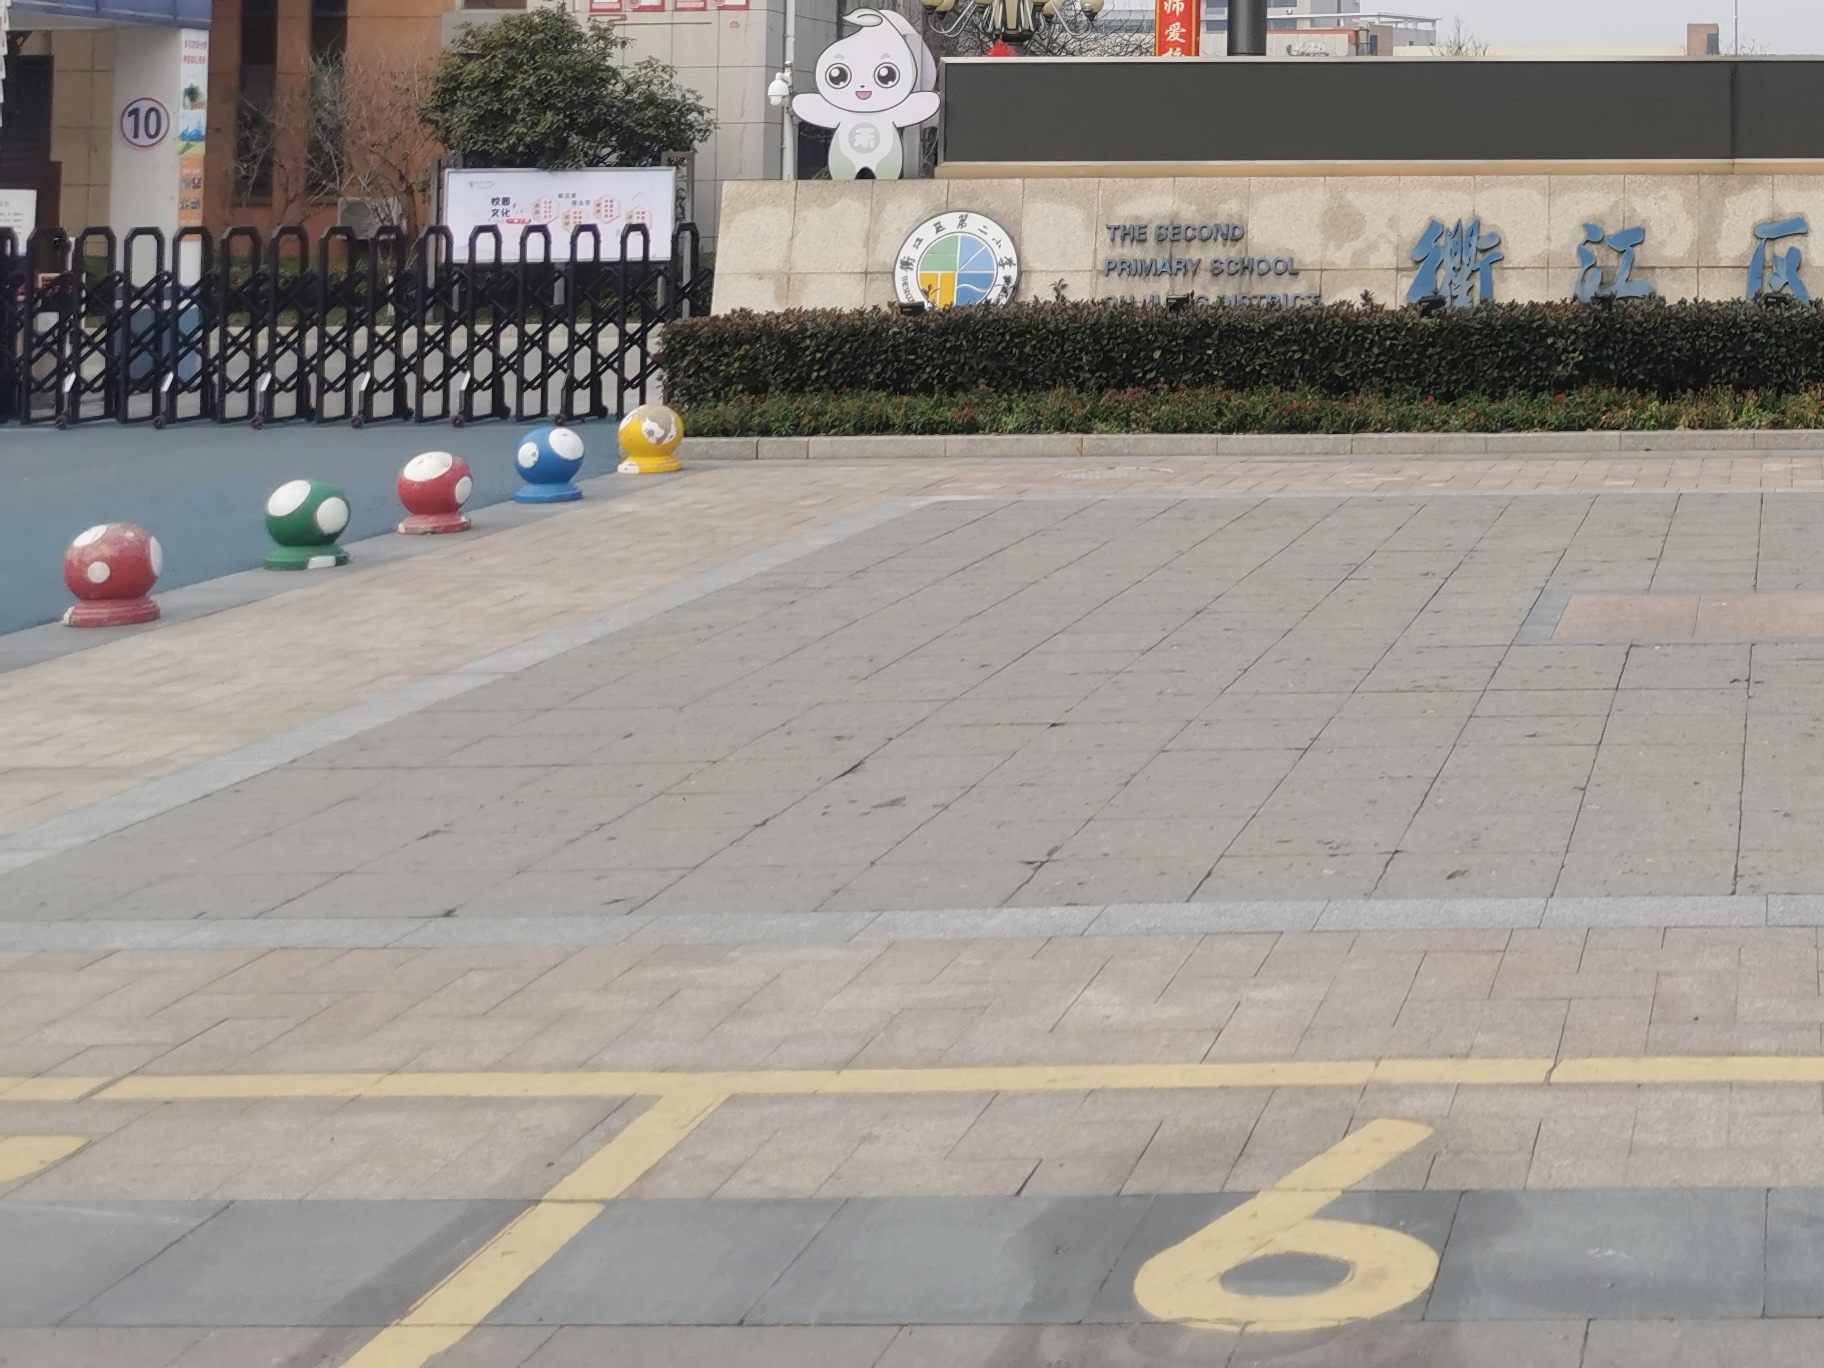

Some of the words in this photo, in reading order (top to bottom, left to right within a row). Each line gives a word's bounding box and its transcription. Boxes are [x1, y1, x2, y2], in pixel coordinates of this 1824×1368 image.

[127, 107, 162, 139] 10
[491, 208, 511, 218] 文化
[1106, 223, 1148, 242] THE
[1154, 222, 1245, 242] SECOND
[1103, 258, 1202, 277] PRIMARY
[1208, 257, 1300, 276] SCHOOL
[1134, 1118, 1440, 1332] 6
